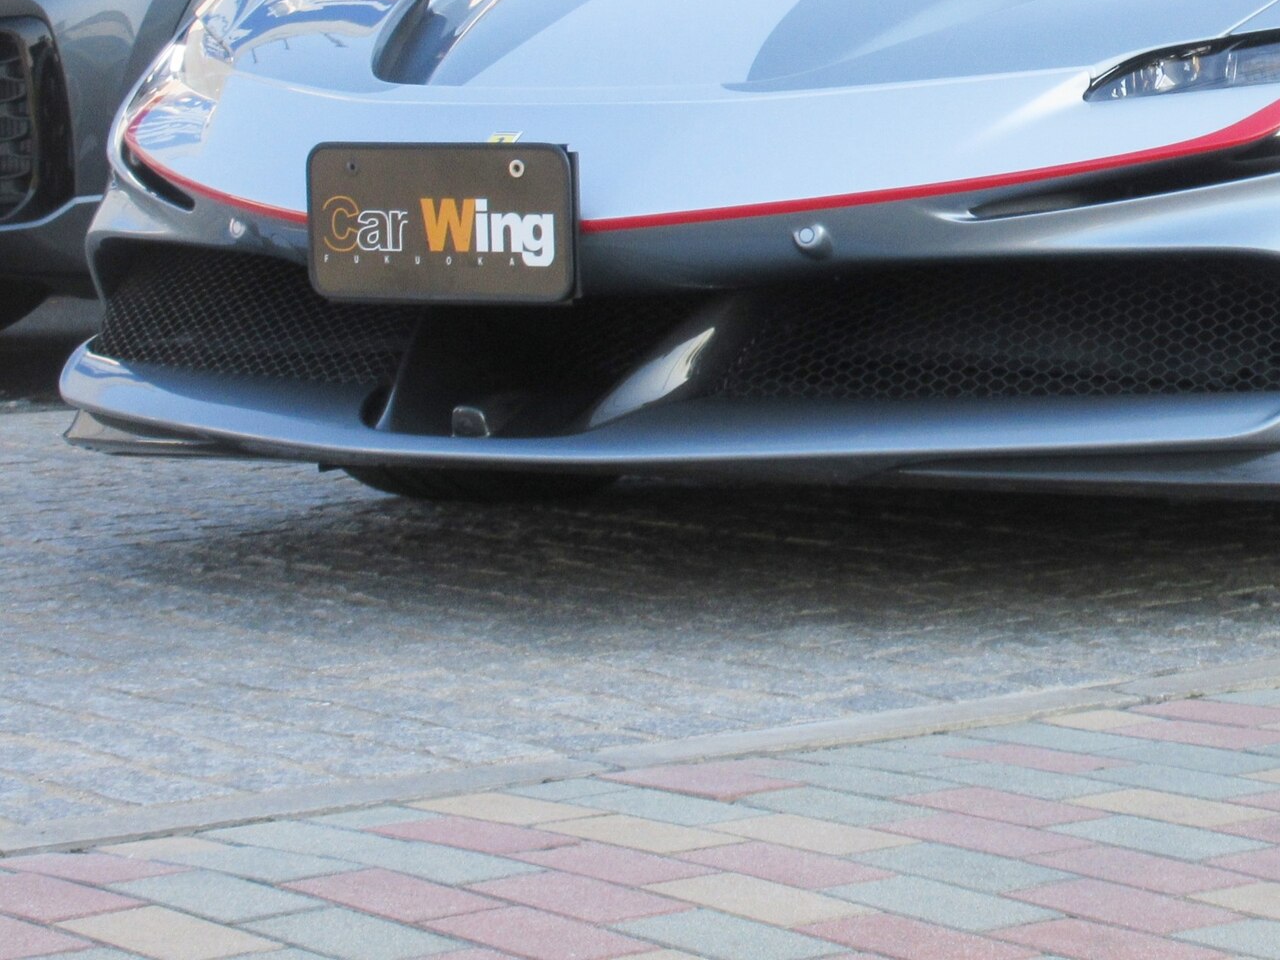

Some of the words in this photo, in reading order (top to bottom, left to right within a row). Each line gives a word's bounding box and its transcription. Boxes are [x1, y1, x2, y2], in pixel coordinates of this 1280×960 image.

[323, 195, 408, 252] Car
[420, 197, 554, 267] Wing
[324, 255, 515, 266] FUKUOKA
